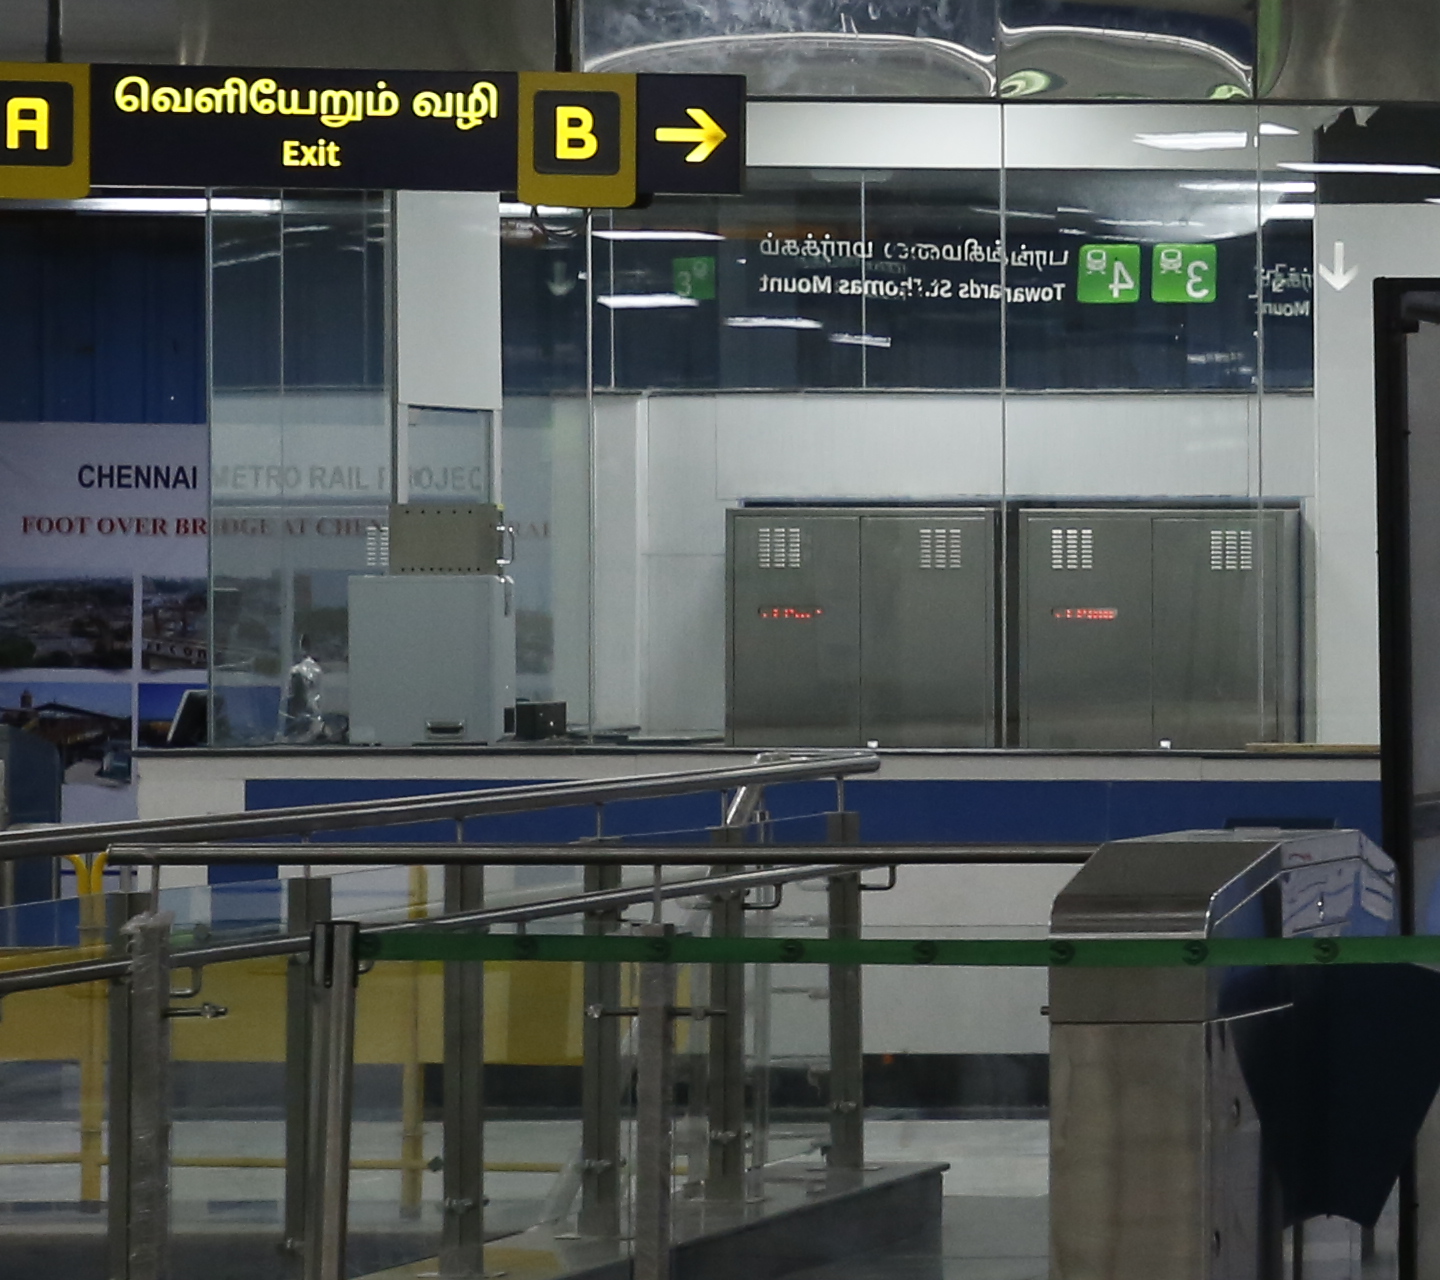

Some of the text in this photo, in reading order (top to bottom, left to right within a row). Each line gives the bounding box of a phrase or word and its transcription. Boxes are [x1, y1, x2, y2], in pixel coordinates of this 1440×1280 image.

[4, 97, 49, 151] A
[114, 75, 499, 131] வெளியேறும் வழி
[282, 138, 342, 168] Exit
[554, 105, 598, 161] B
[77, 463, 198, 489] CHENNAI
[309, 465, 369, 490] RAIL
[21, 516, 91, 535] FOOT
[97, 516, 168, 536] OVER
